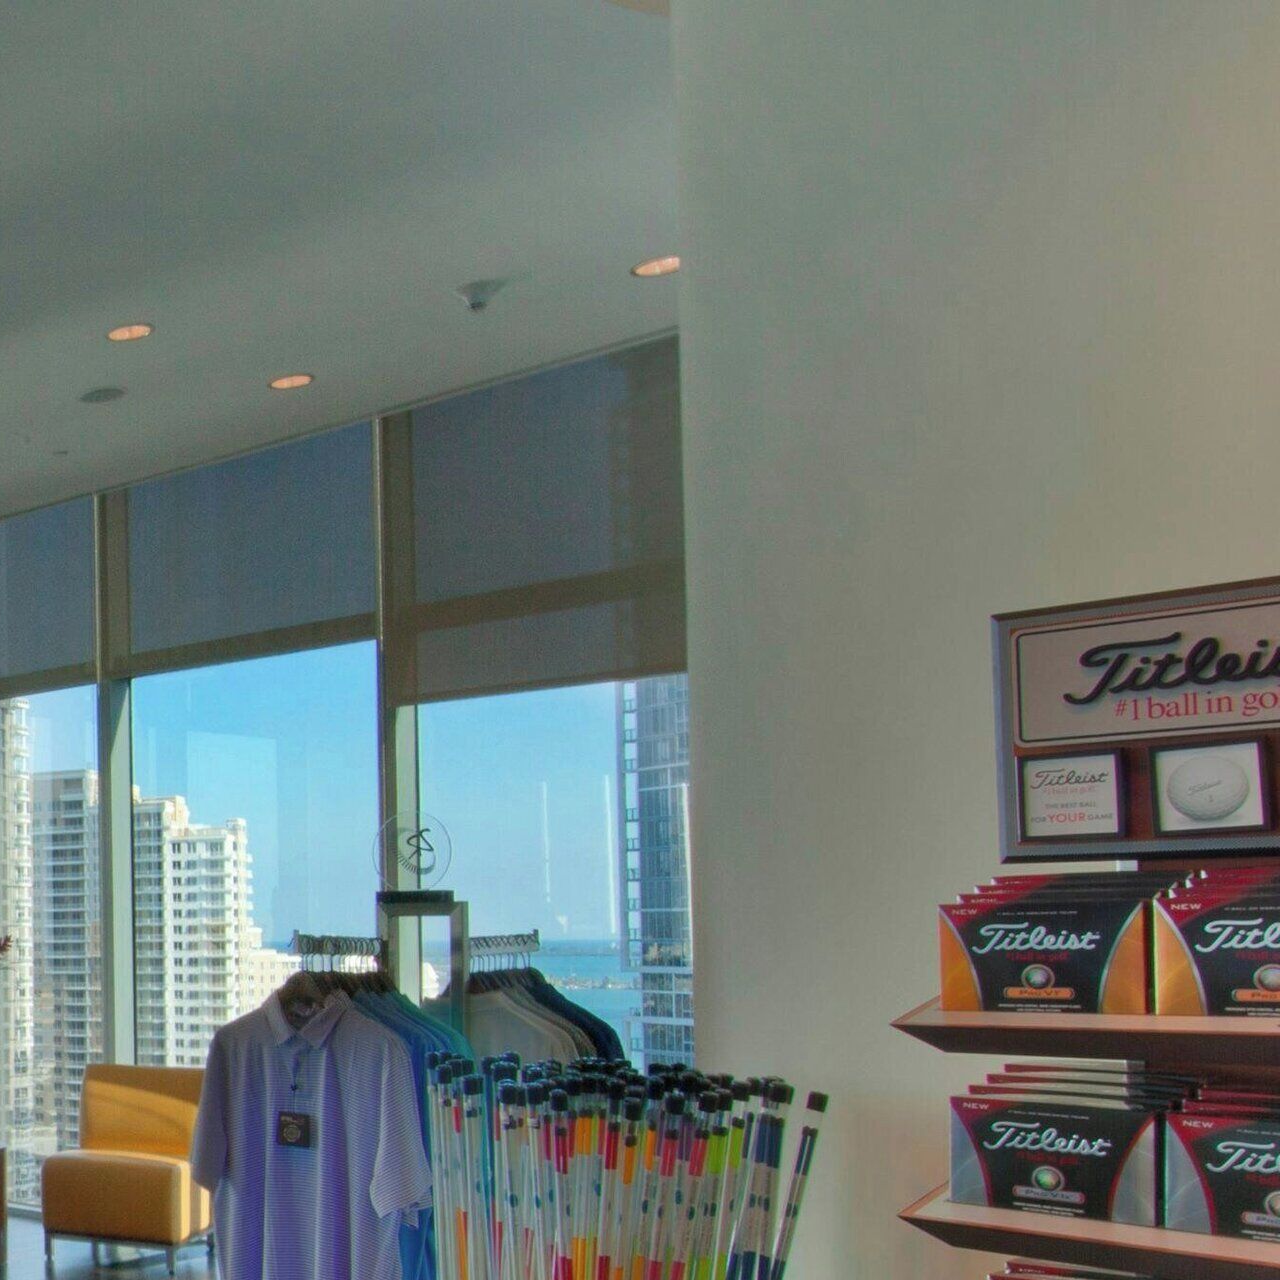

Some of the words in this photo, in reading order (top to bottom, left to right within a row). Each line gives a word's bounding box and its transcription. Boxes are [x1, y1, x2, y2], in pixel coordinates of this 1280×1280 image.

[1146, 692, 1198, 719] ball
[1206, 691, 1233, 714] in
[1242, 690, 1280, 717] go
[1030, 768, 1109, 789] Titleist
[1047, 812, 1087, 823] YOUR
[972, 922, 1101, 955] Titleist
[963, 1102, 990, 1110] NEW
[1182, 1120, 1214, 1128] NEW
[983, 1121, 1113, 1157] Titleist
